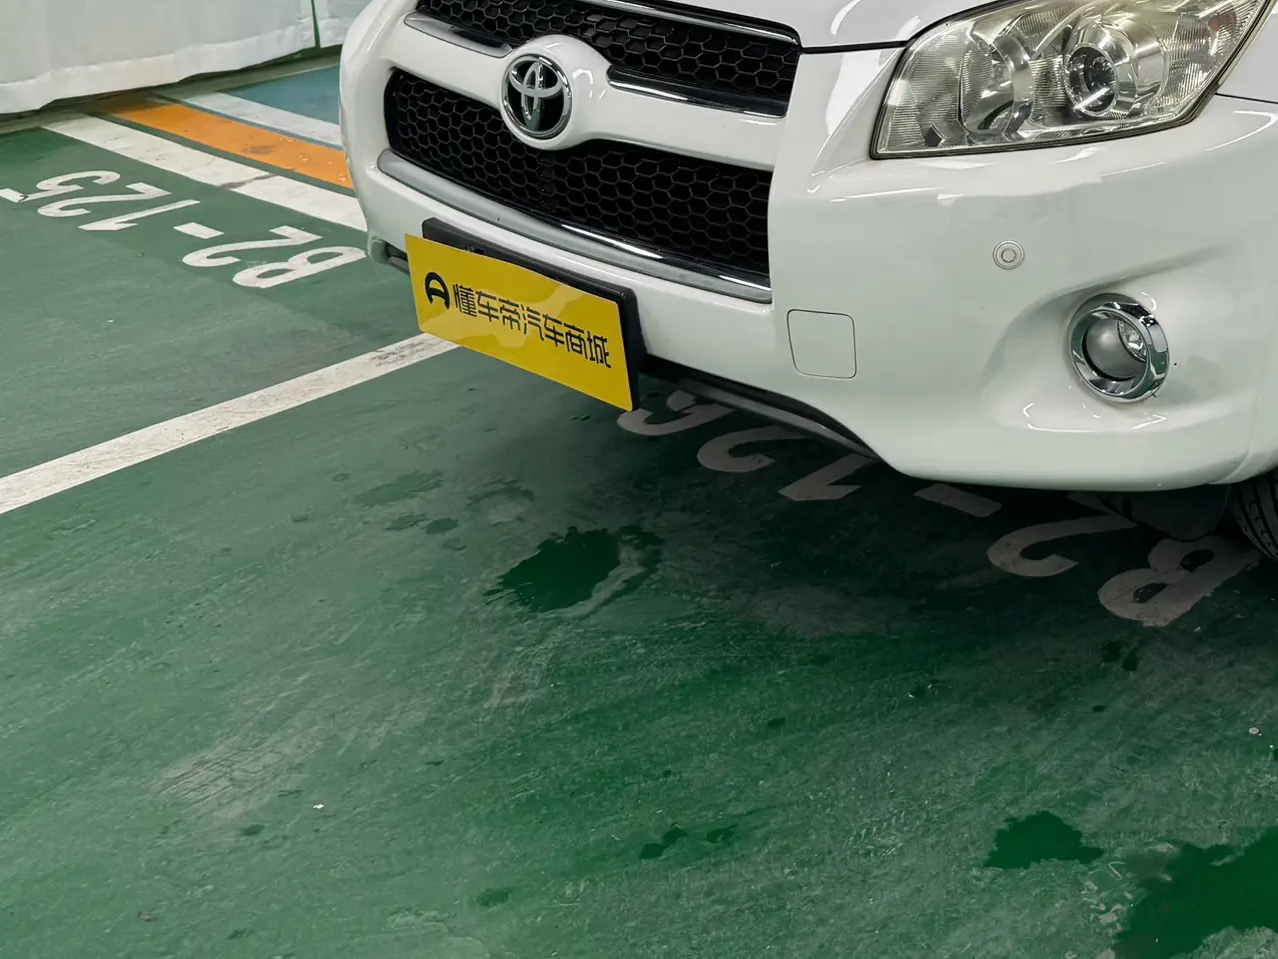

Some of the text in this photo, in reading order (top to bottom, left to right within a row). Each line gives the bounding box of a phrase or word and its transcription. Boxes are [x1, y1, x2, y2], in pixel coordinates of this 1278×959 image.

[0, 170, 367, 289] B2-125
[452, 283, 612, 369] 懂车帝汽车商城
